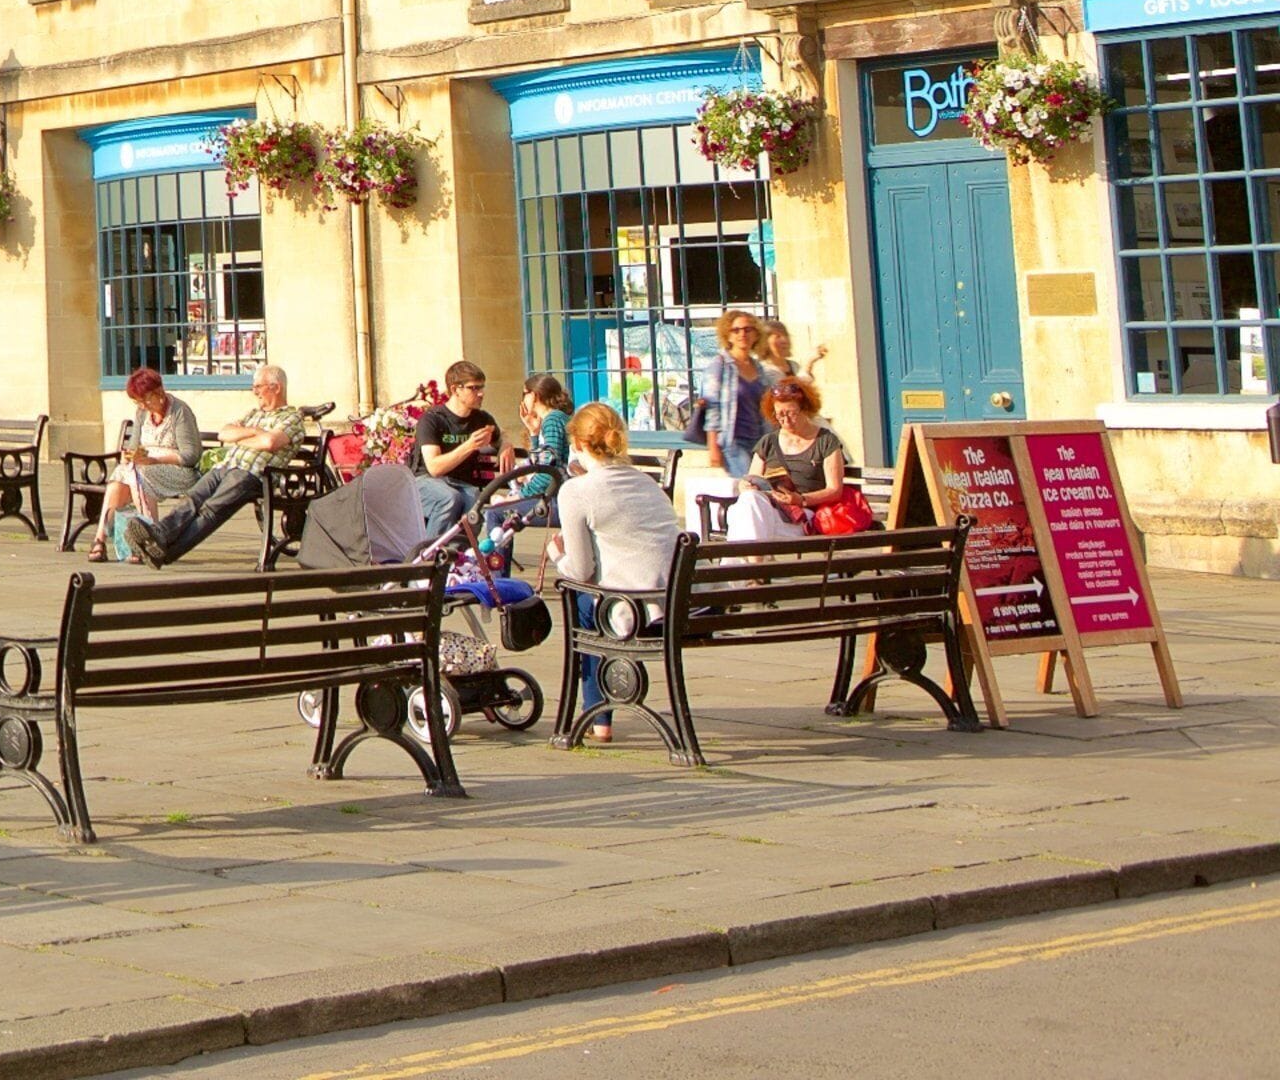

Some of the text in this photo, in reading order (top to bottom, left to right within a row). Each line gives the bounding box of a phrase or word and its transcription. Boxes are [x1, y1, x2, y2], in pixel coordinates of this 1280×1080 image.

[577, 93, 653, 114] INFORMATION
[904, 65, 976, 137] Bath
[962, 446, 986, 465] The
[1056, 445, 1076, 461] The
[945, 466, 1015, 489] Real Italian
[1043, 463, 1100, 483] Real Italian
[993, 490, 1014, 507] Co.
